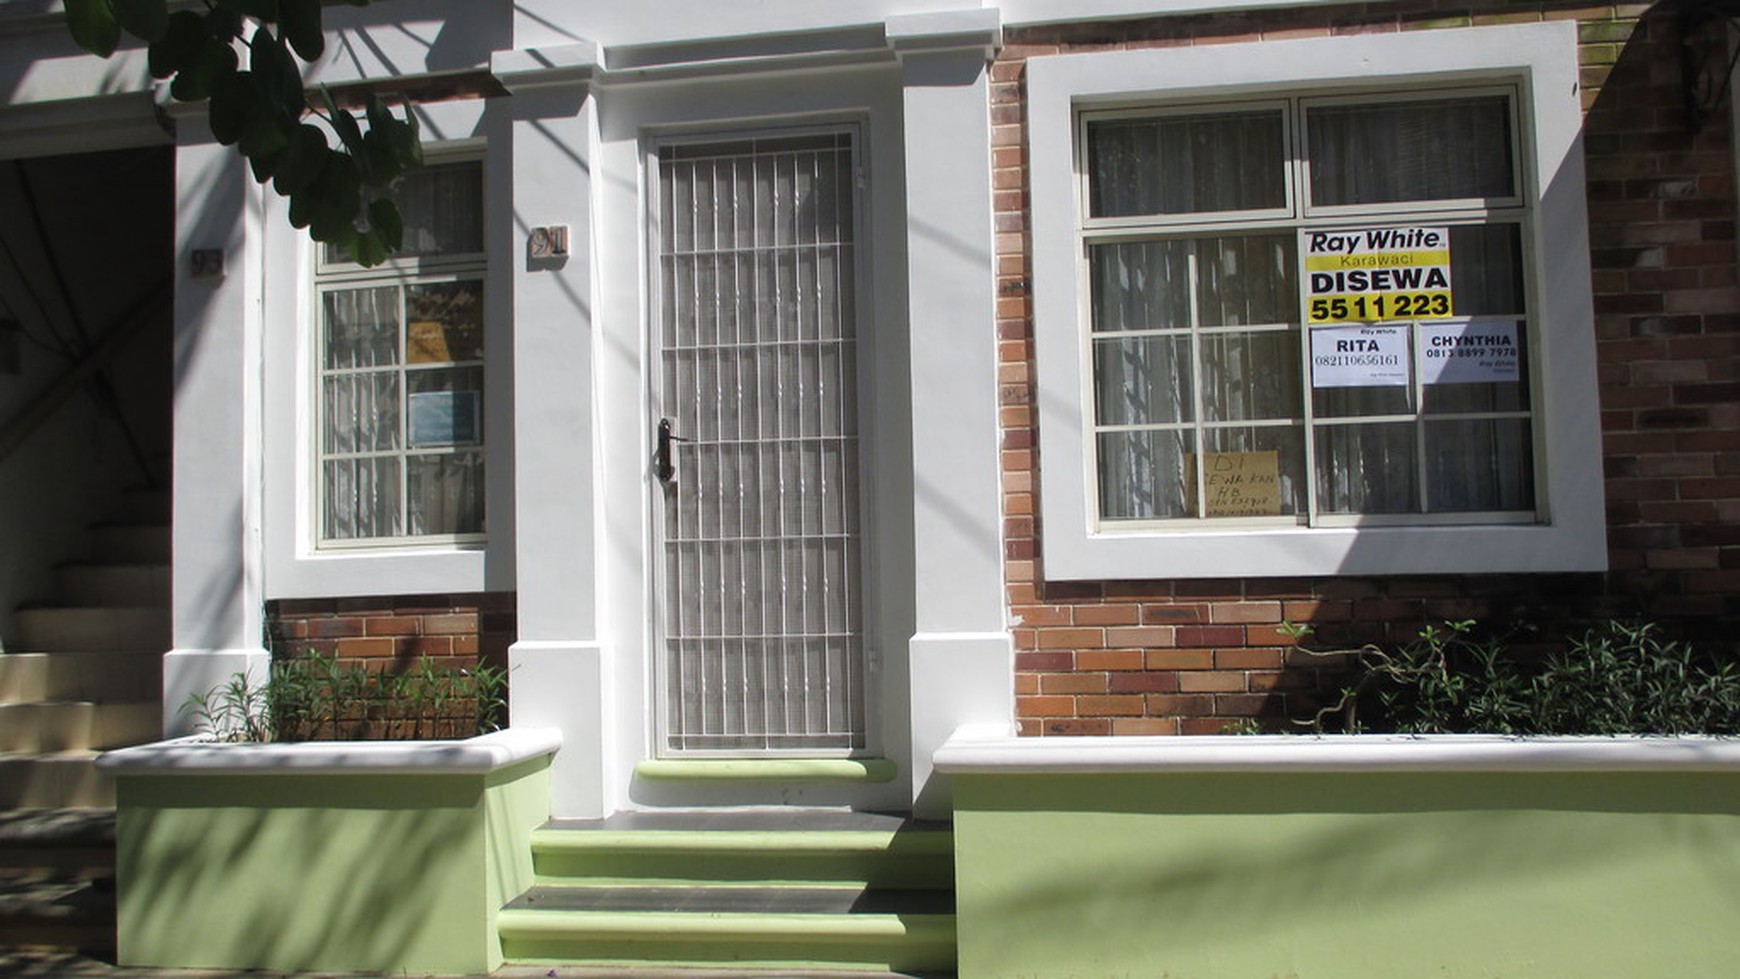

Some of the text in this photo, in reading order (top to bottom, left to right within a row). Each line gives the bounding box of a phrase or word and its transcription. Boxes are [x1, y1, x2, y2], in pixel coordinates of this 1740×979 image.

[530, 226, 568, 256] 91
[1309, 229, 1440, 254] Ray White
[1340, 254, 1414, 268] Karawaci
[1311, 268, 1448, 294] DISEWA
[1394, 295, 1449, 316] 223
[1336, 340, 1380, 352] RITA
[1431, 335, 1512, 347] CHYNTHIA
[1426, 348, 1454, 358] 0813
[1315, 355, 1399, 366] 082110656161
